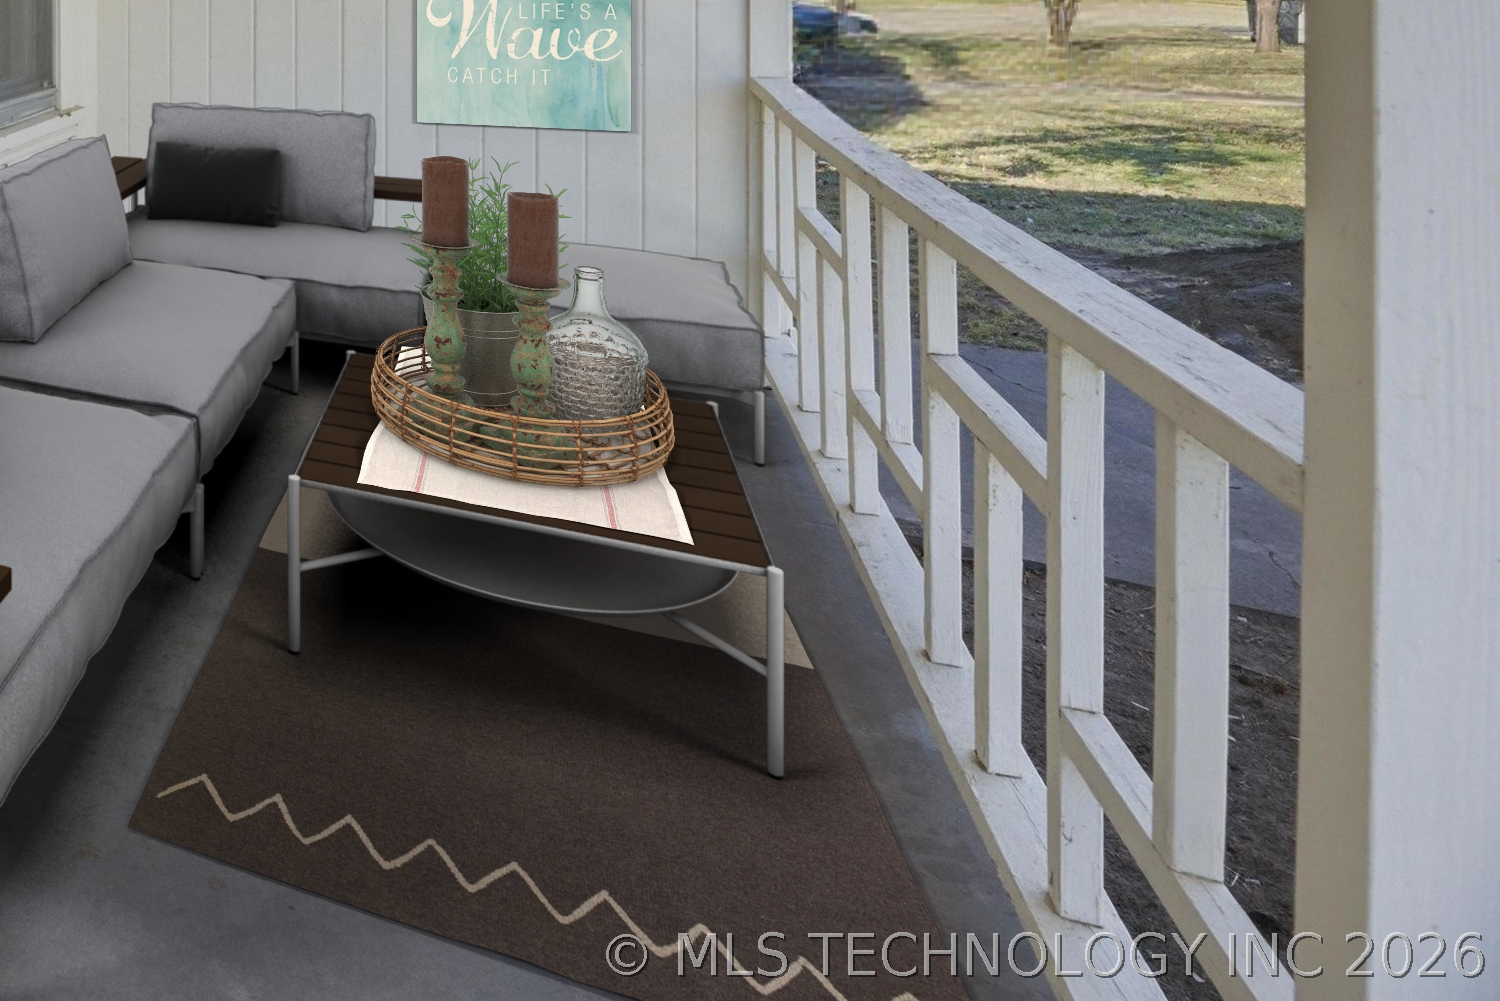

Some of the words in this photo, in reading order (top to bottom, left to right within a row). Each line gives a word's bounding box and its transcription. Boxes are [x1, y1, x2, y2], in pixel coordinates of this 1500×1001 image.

[518, 2, 591, 20] LIFE'S
[604, 3, 617, 20] A
[447, 66, 518, 85] CATCH
[532, 69, 552, 86] IT
